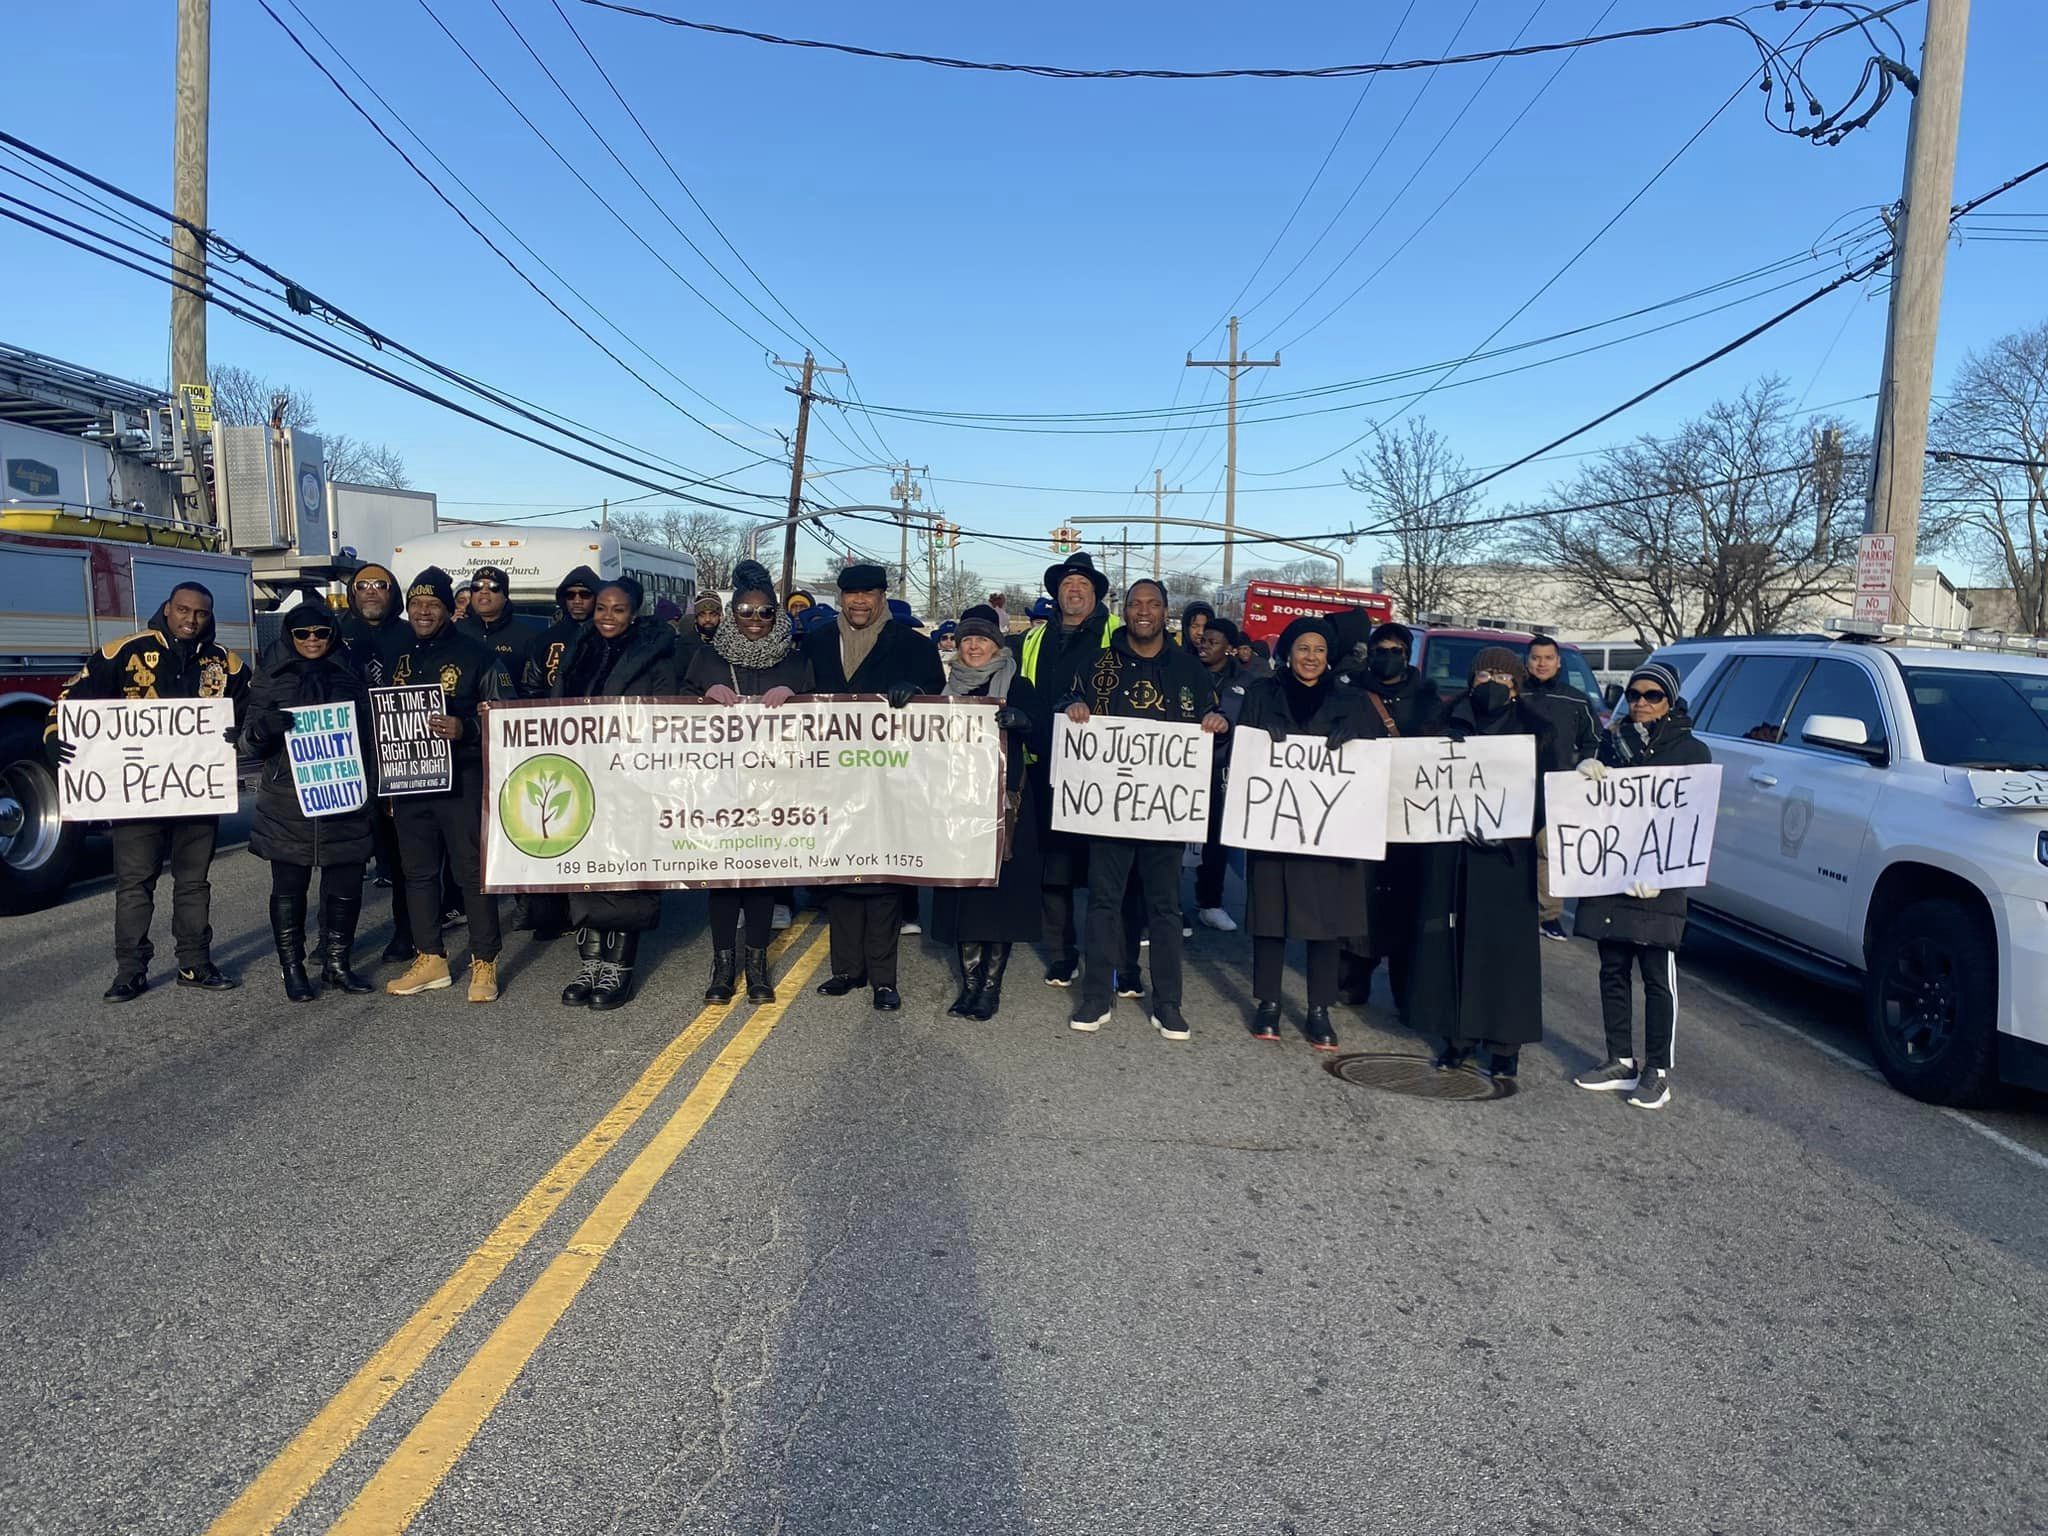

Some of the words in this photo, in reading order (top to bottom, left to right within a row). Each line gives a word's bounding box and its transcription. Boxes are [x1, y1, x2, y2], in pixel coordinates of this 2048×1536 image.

[1861, 550, 1893, 561] PARKING
[1871, 538, 1885, 550] NO
[441, 566, 477, 578] Presbyt
[505, 566, 540, 576] Church
[467, 557, 514, 566] Memorial
[1272, 604, 1334, 618] ROOSE
[1865, 597, 1880, 609] NO
[374, 693, 397, 713] THE
[398, 690, 428, 711] TIME
[429, 689, 441, 709] IS
[62, 704, 101, 741] NO
[106, 705, 216, 741] JUSTICE
[289, 707, 334, 734] EOPLE
[336, 706, 350, 729] OF
[502, 714, 642, 748] MEMORIAL
[652, 713, 862, 744] PRESBYTERIAN
[871, 712, 984, 744] CHURCH
[290, 731, 354, 762] QUALITY
[381, 741, 411, 762] RIGHT
[414, 740, 429, 759] TO
[431, 739, 447, 758] DO
[1064, 727, 1098, 761] NO
[1103, 726, 1200, 769] JUSTICE
[1270, 742, 1356, 776] EQUAL
[1439, 740, 1467, 761] I
[295, 765, 311, 784] DO
[311, 761, 333, 782] NOT
[333, 759, 360, 779] FEAR
[383, 760, 408, 778] WHAT
[410, 760, 419, 776] IS
[420, 758, 448, 775] RIGHT.
[609, 753, 625, 770] A
[633, 751, 734, 771] CHURCH
[742, 751, 776, 769] ON
[784, 750, 831, 769] THE
[838, 749, 910, 769] GROW
[64, 768, 107, 804] NO
[122, 762, 225, 804] PEACE
[1415, 764, 1453, 790] AM
[1469, 761, 1487, 791] A
[300, 780, 364, 813] EQUALITY
[1062, 780, 1103, 817] NO
[1113, 781, 1206, 825] PEACE
[1585, 774, 1692, 809] JUSTICE
[658, 806, 830, 830] 516-623-9561
[1243, 776, 1351, 846] PAY
[1403, 787, 1506, 835] MAN
[671, 835, 816, 852] www.mpcliny.org
[1557, 823, 1628, 877] FOR
[1633, 814, 1707, 876] ALL
[557, 861, 581, 875] 189
[587, 860, 647, 876] Babylon
[652, 858, 719, 874] Turnpike
[724, 856, 803, 871] Roosevelt,
[808, 855, 841, 869] New
[846, 853, 879, 867] York
[885, 854, 924, 868] 11575
